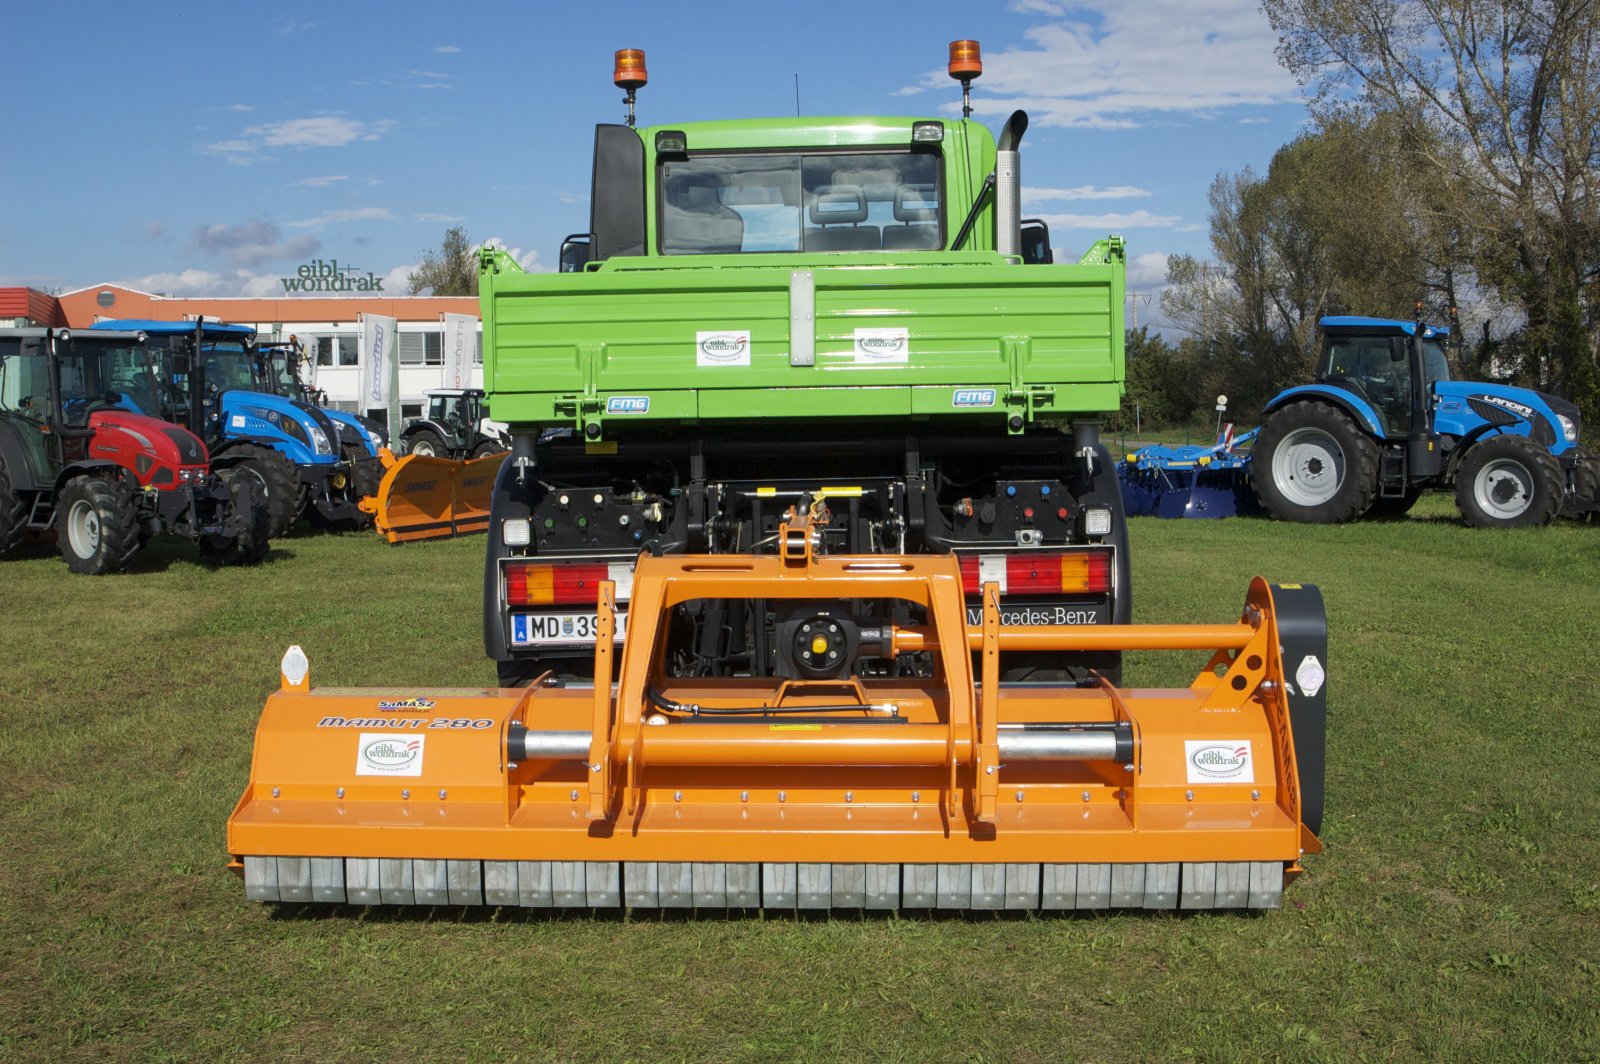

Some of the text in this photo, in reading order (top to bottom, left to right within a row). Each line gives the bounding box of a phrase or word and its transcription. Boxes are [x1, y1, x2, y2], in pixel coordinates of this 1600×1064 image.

[281, 272, 385, 292] wondrak
[705, 342, 740, 351] wondrak
[967, 607, 1097, 626] Mcedes-Benz
[531, 617, 559, 638] MD
[317, 716, 496, 730] MAMUT 280
[375, 743, 393, 752] eibl
[369, 749, 410, 758] wondrak
[1203, 750, 1221, 760] eibl
[1197, 756, 1239, 765] wondrak
